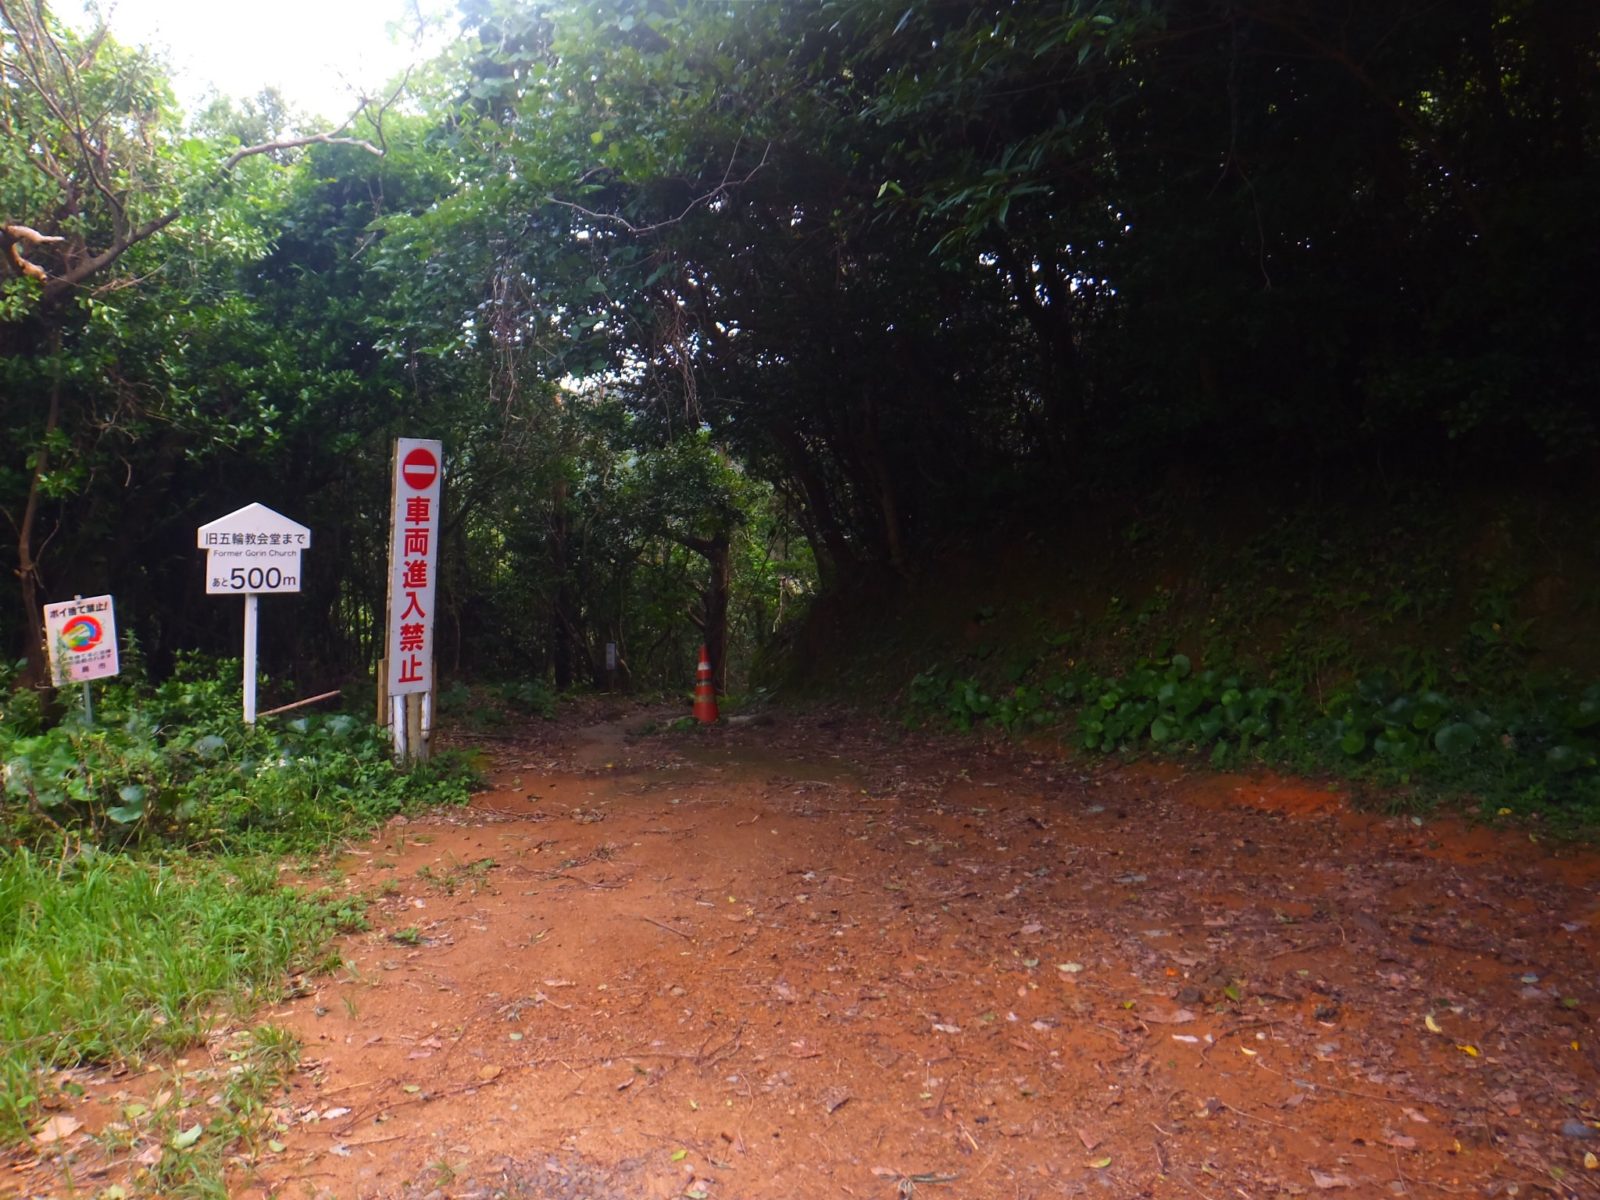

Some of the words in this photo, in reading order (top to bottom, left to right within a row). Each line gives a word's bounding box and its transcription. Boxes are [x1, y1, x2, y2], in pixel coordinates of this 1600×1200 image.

[205, 532, 306, 546] 旧五輪教会堂まで
[213, 549, 243, 557] Former
[245, 549, 267, 557] Gorin
[269, 549, 297, 557] Church
[398, 496, 431, 684] 車両進入禁止
